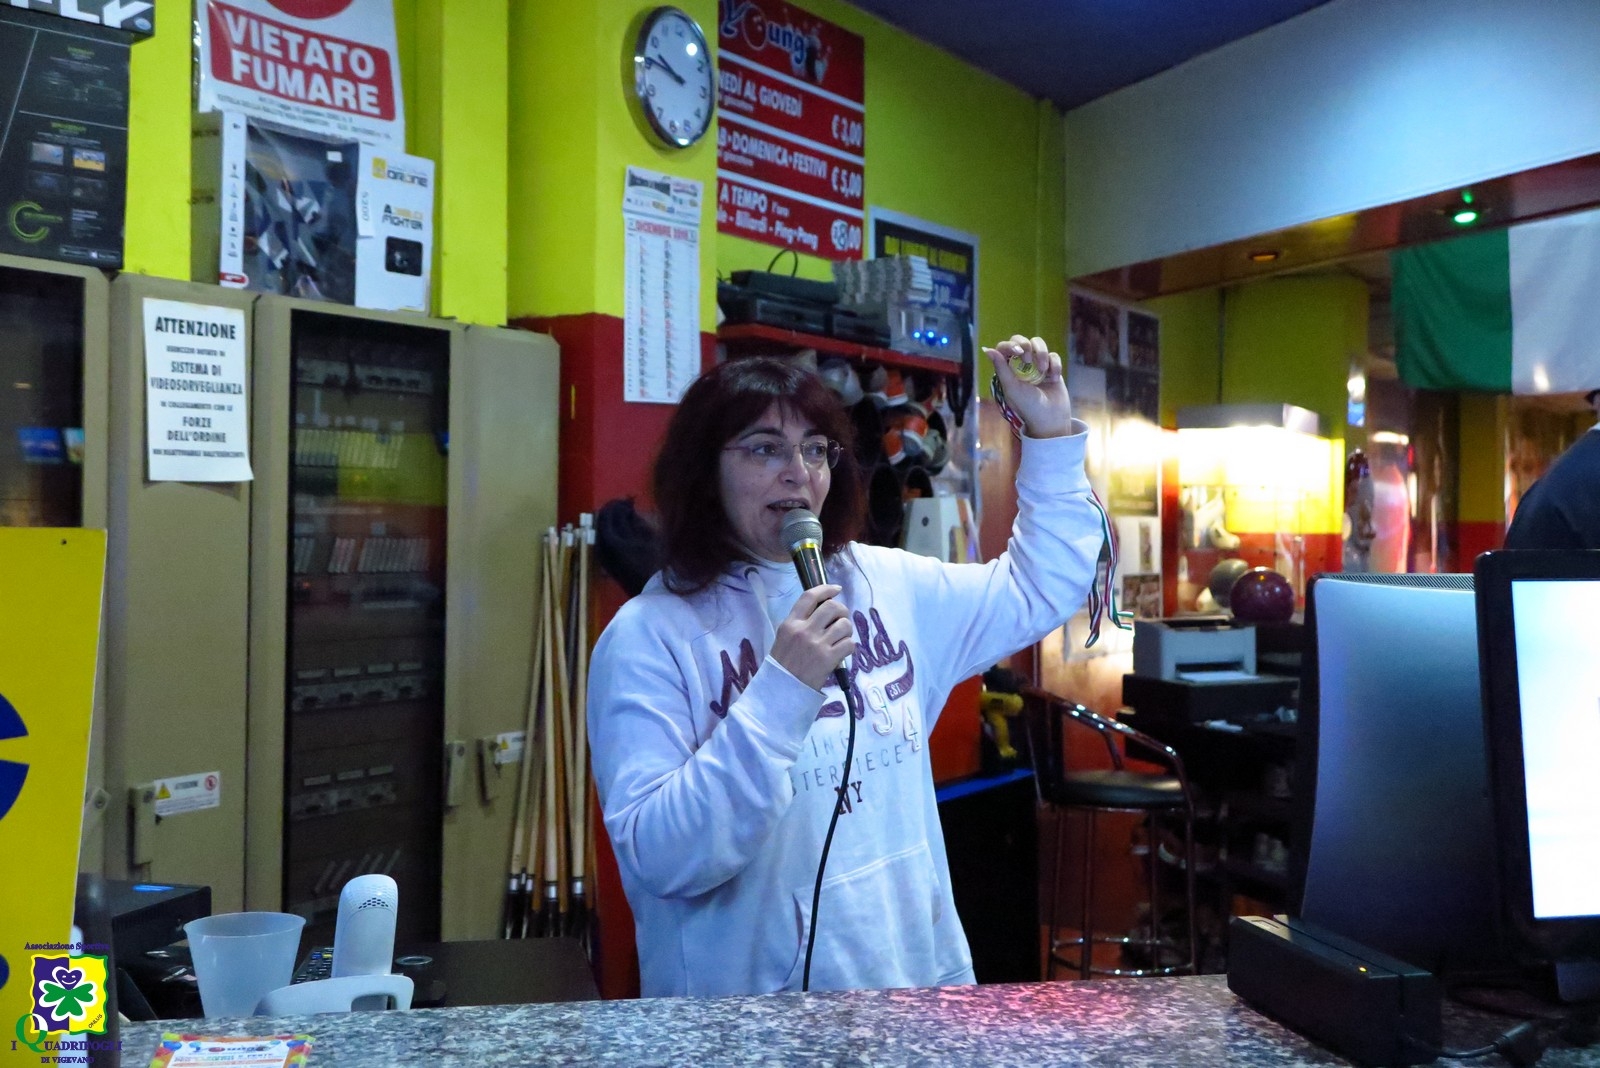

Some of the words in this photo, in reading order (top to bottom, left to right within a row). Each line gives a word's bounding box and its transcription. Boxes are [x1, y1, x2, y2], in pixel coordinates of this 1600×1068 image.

[224, 9, 376, 80] VIETATO
[231, 47, 382, 116] FUMARE
[720, 182, 730, 204] A
[731, 185, 769, 214] TEMPO
[155, 315, 237, 341] ATTENZIONE
[170, 360, 210, 376] SISTEMA
[211, 363, 222, 377] DI
[150, 376, 244, 396] VIDEOSORVEGLIANZA
[182, 416, 213, 429] FORZE
[834, 780, 864, 815] NY
